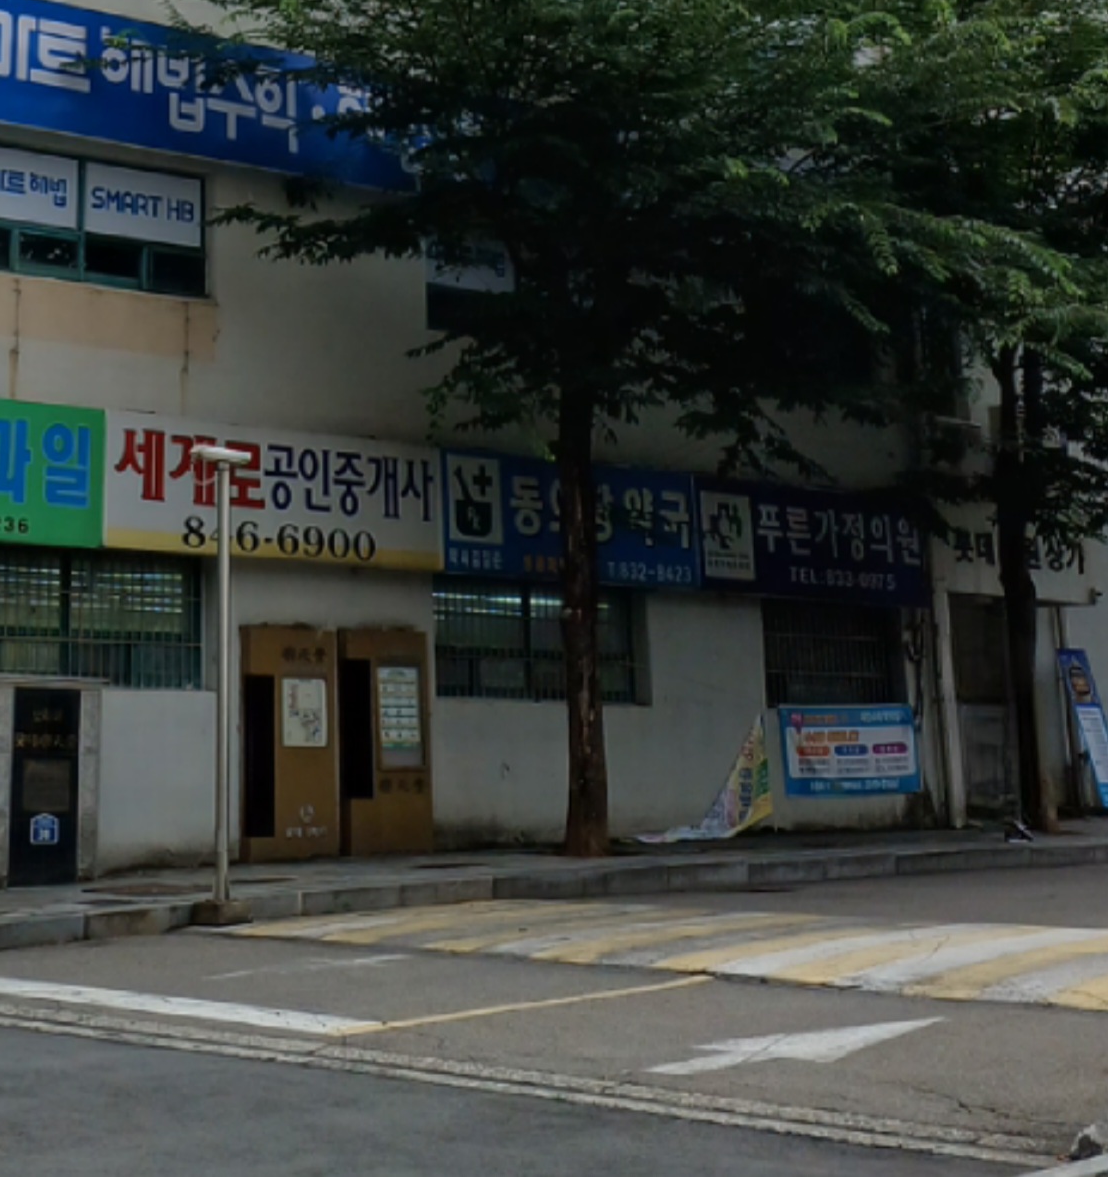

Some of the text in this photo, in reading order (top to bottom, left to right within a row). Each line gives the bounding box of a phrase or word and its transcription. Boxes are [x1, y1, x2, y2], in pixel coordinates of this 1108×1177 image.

[91, 187, 195, 223] SMART HB
[757, 503, 921, 566] 푸른가정의원
